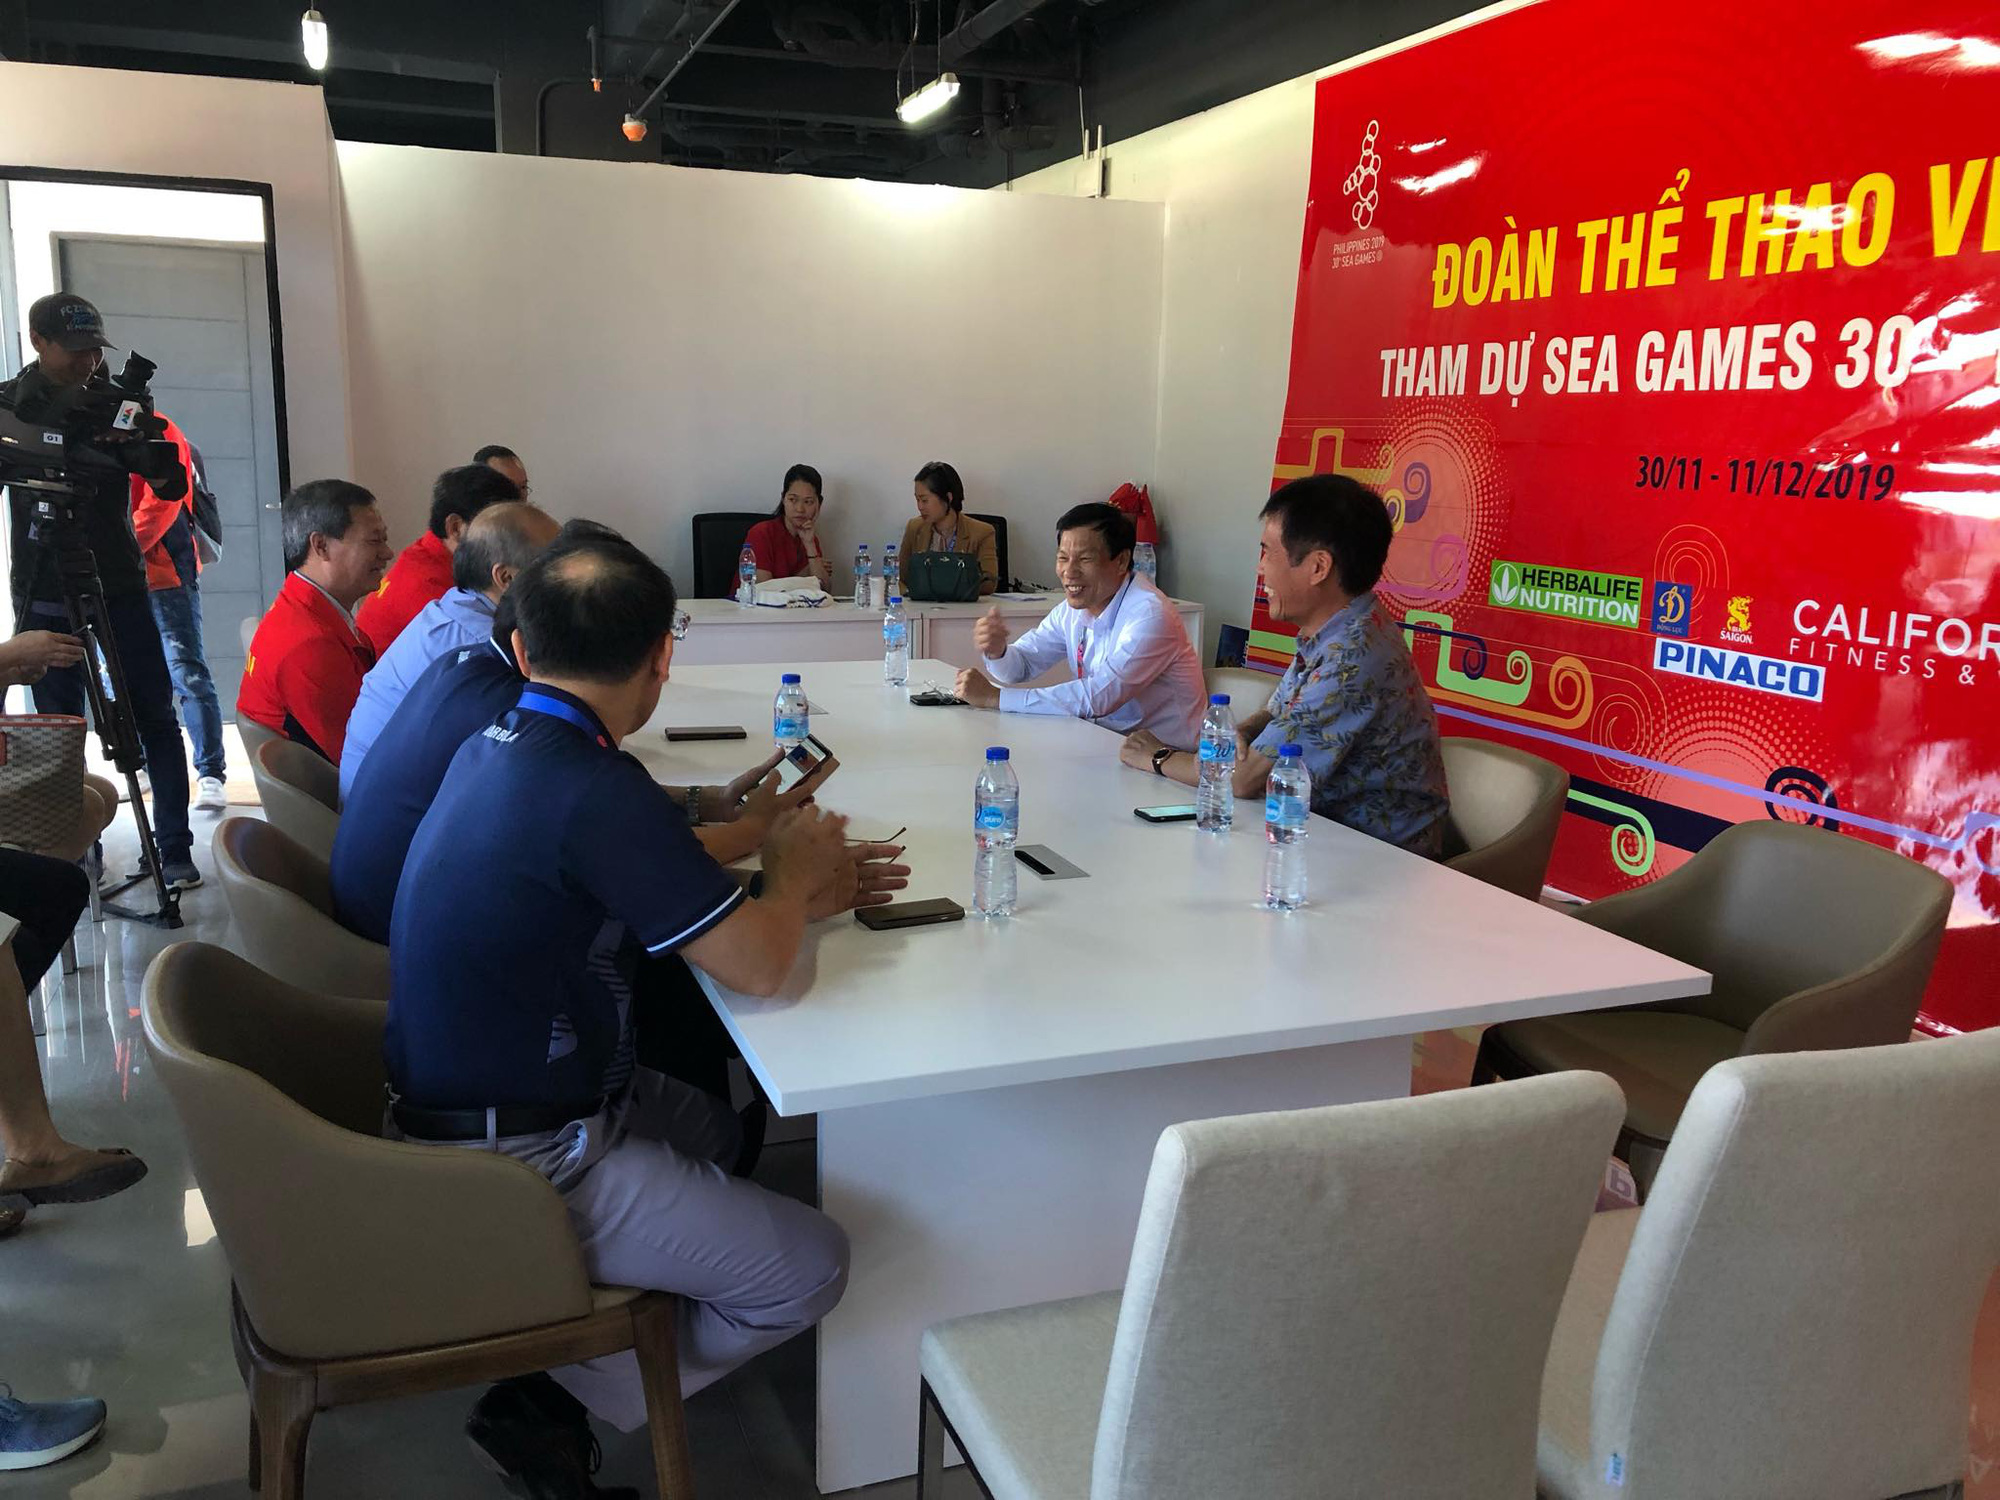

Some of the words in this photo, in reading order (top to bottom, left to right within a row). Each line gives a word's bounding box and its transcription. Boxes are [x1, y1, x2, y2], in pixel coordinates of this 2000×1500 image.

[1432, 216, 1558, 308] ĐOÀN
[1577, 168, 1690, 294] THỂ
[1706, 172, 1896, 281] THAO
[1380, 344, 1469, 397] THAM
[1479, 331, 1536, 407] DỰ
[1542, 334, 1619, 395] SEA
[1635, 320, 1816, 393] GAMES
[1834, 314, 1914, 389] 30
[1635, 456, 1702, 491] 30/11
[1728, 459, 1895, 501] 11/12/2019
[1519, 587, 1638, 624] NUTRITION
[1522, 567, 1640, 601] HERBALIFE
[1794, 599, 2000, 661] CALIFOR
[1659, 641, 1819, 697] PINACO
[1789, 637, 1936, 679] FITNESS
[1958, 664, 1976, 686] &
